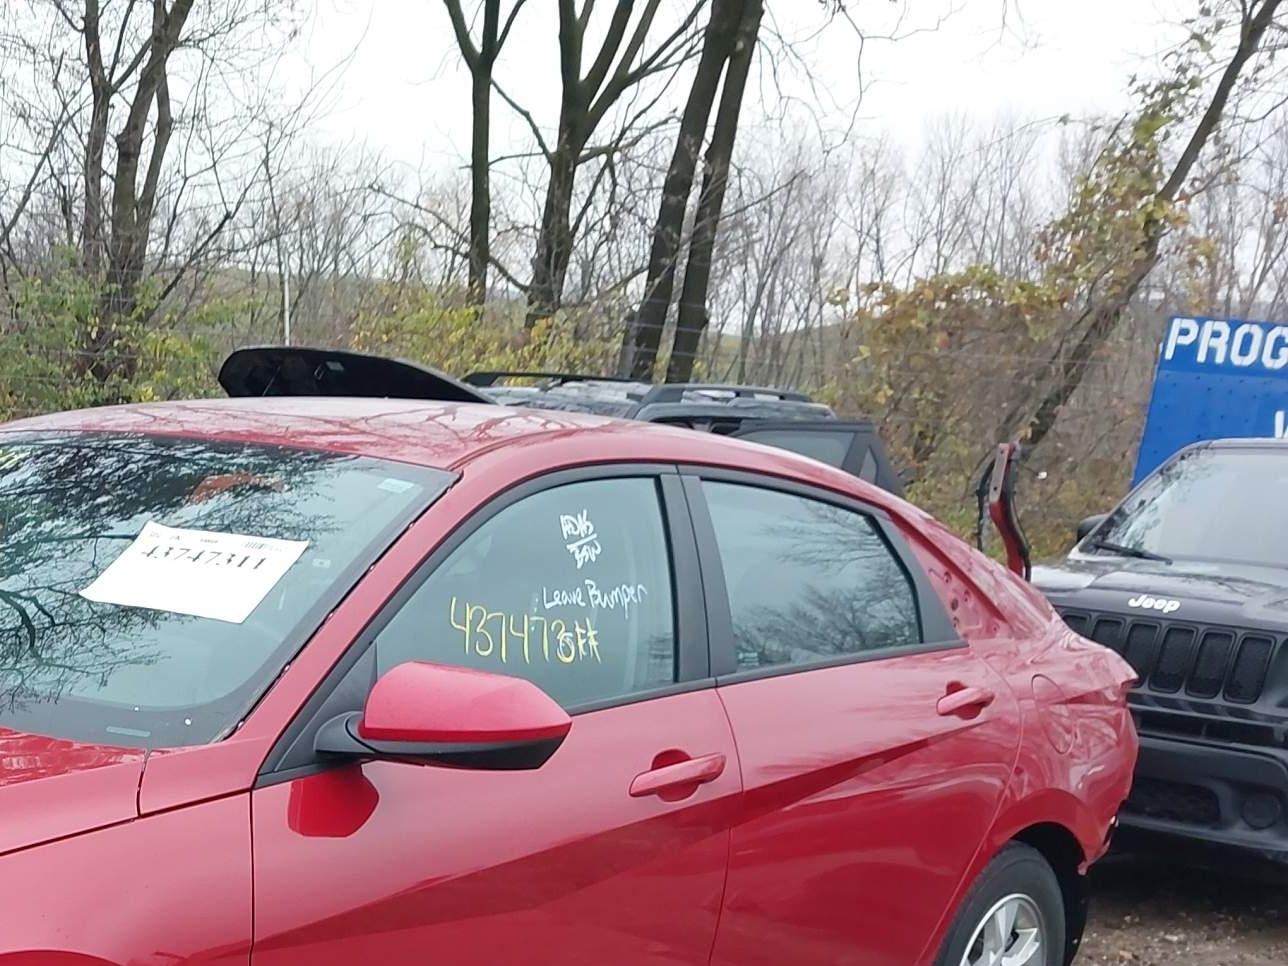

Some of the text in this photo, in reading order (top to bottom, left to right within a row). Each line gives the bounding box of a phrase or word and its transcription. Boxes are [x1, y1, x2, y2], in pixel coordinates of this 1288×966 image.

[141, 545, 267, 570] 43747311
[543, 579, 648, 620] Leave Bumper
[1128, 594, 1181, 614] Jeep
